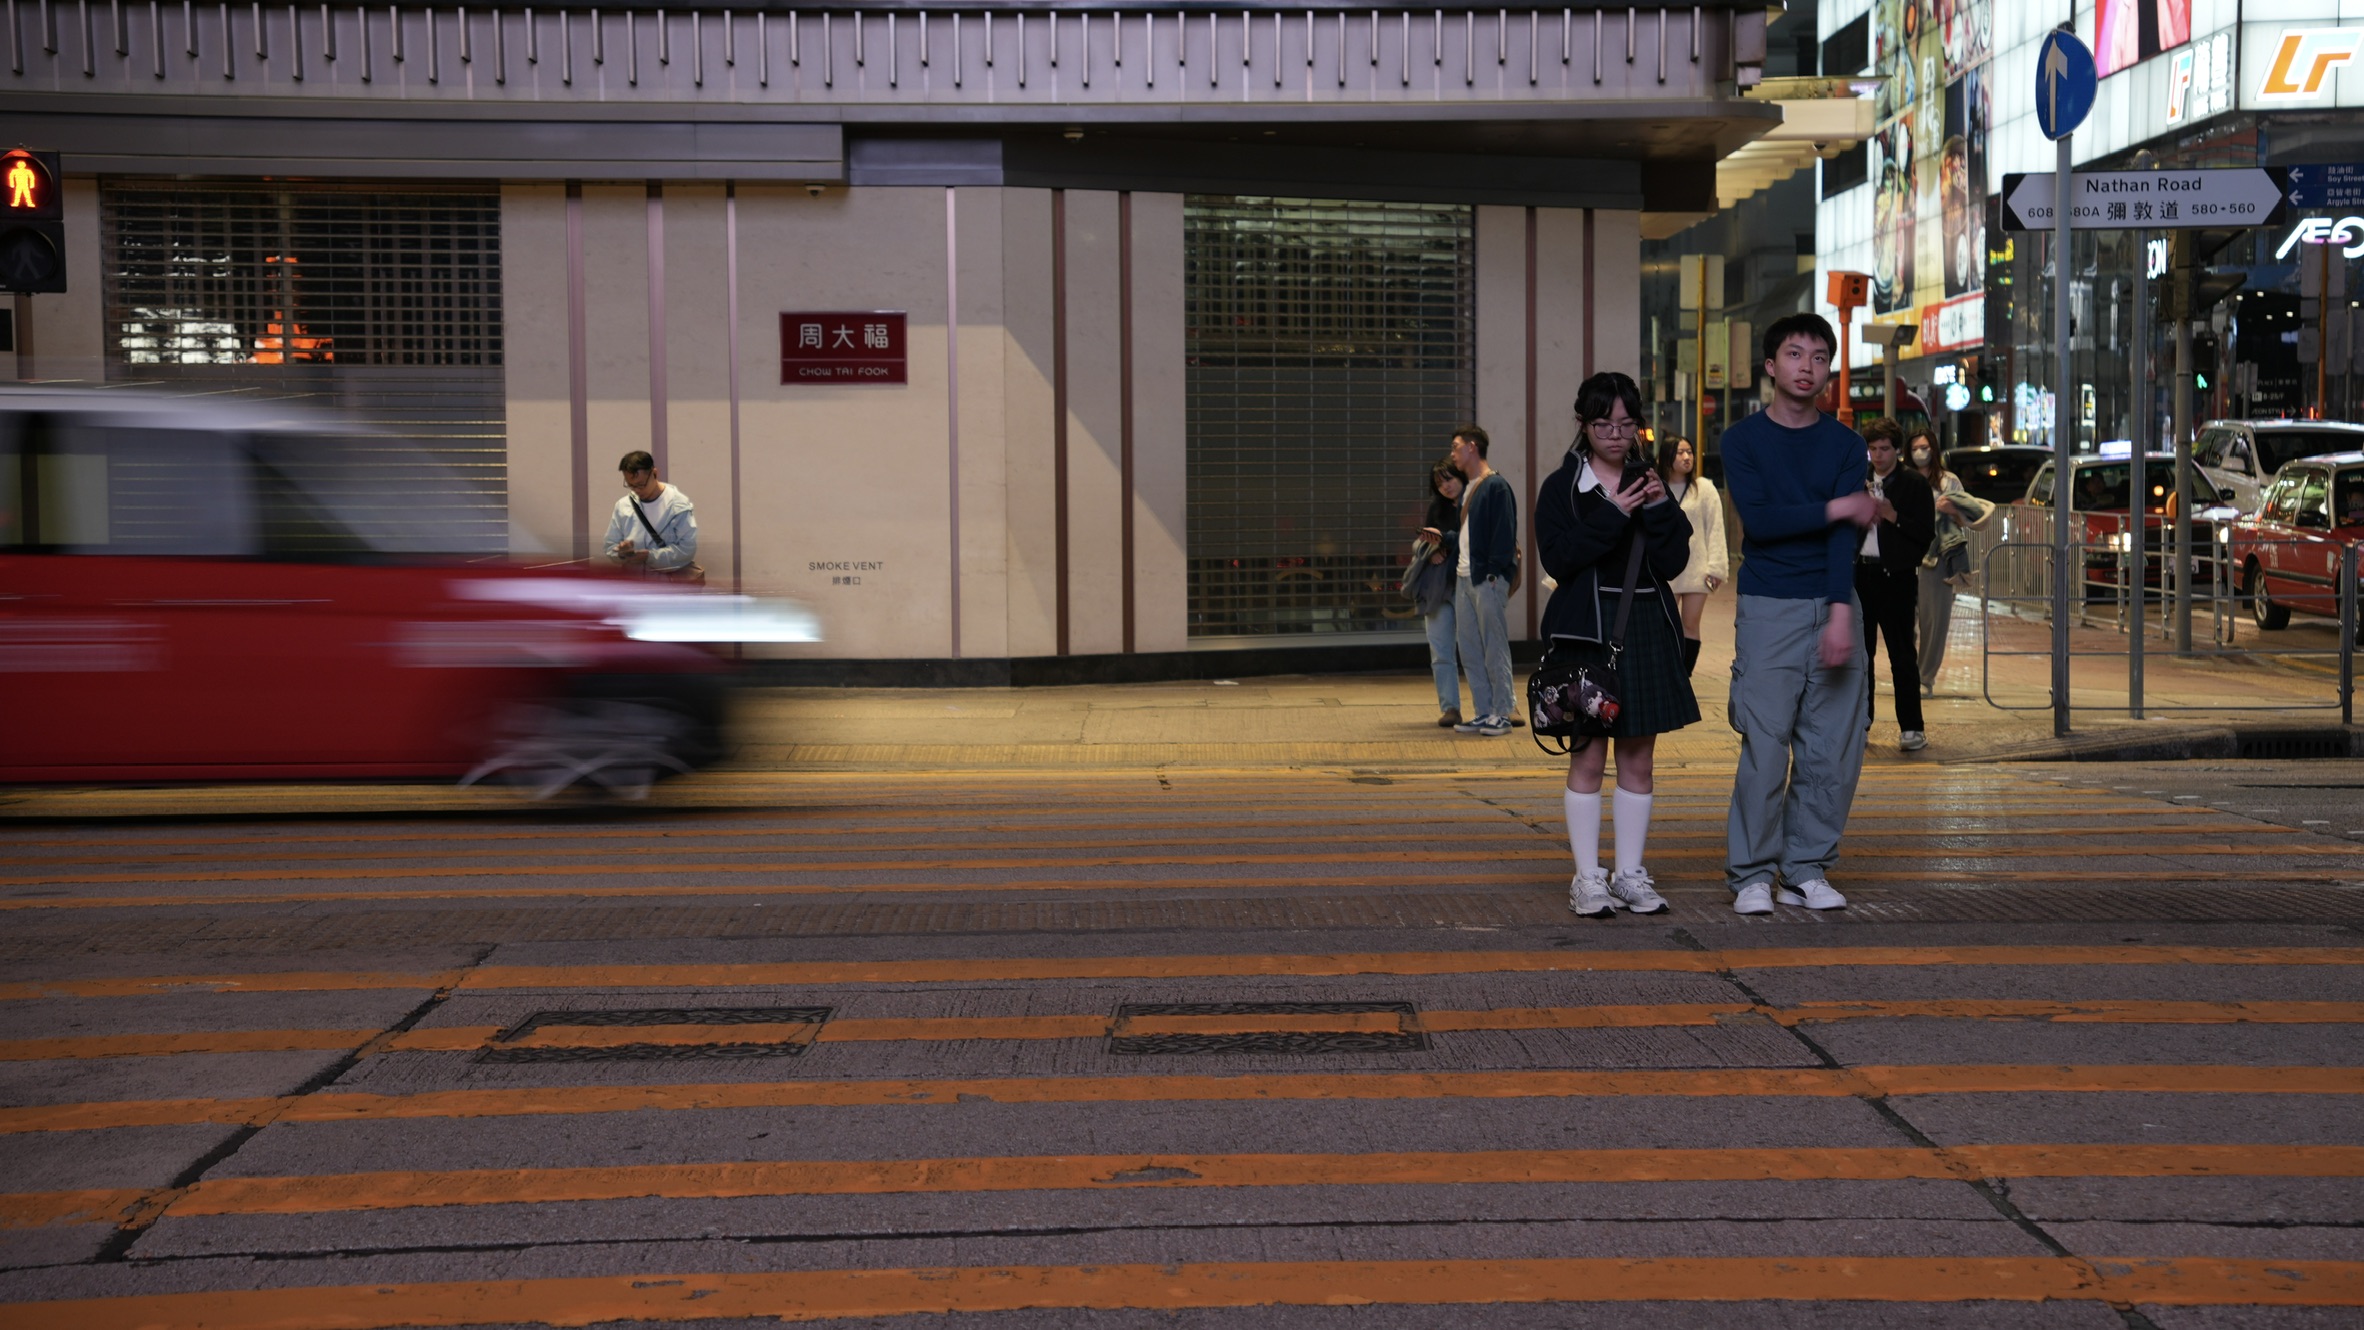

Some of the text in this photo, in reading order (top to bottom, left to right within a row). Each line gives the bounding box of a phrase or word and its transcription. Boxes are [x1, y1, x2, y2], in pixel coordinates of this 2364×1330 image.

[2328, 175, 2341, 183] Soy
[2086, 177, 2202, 193] Nathan Road
[2327, 198, 2350, 207] Argyle
[2070, 206, 2099, 217] 80A
[2107, 200, 2179, 221] 彌敦道
[799, 324, 889, 349] 周大福
[799, 367, 888, 376] CHOW TAI FOOK
[809, 561, 883, 571] SMOKE VENT
